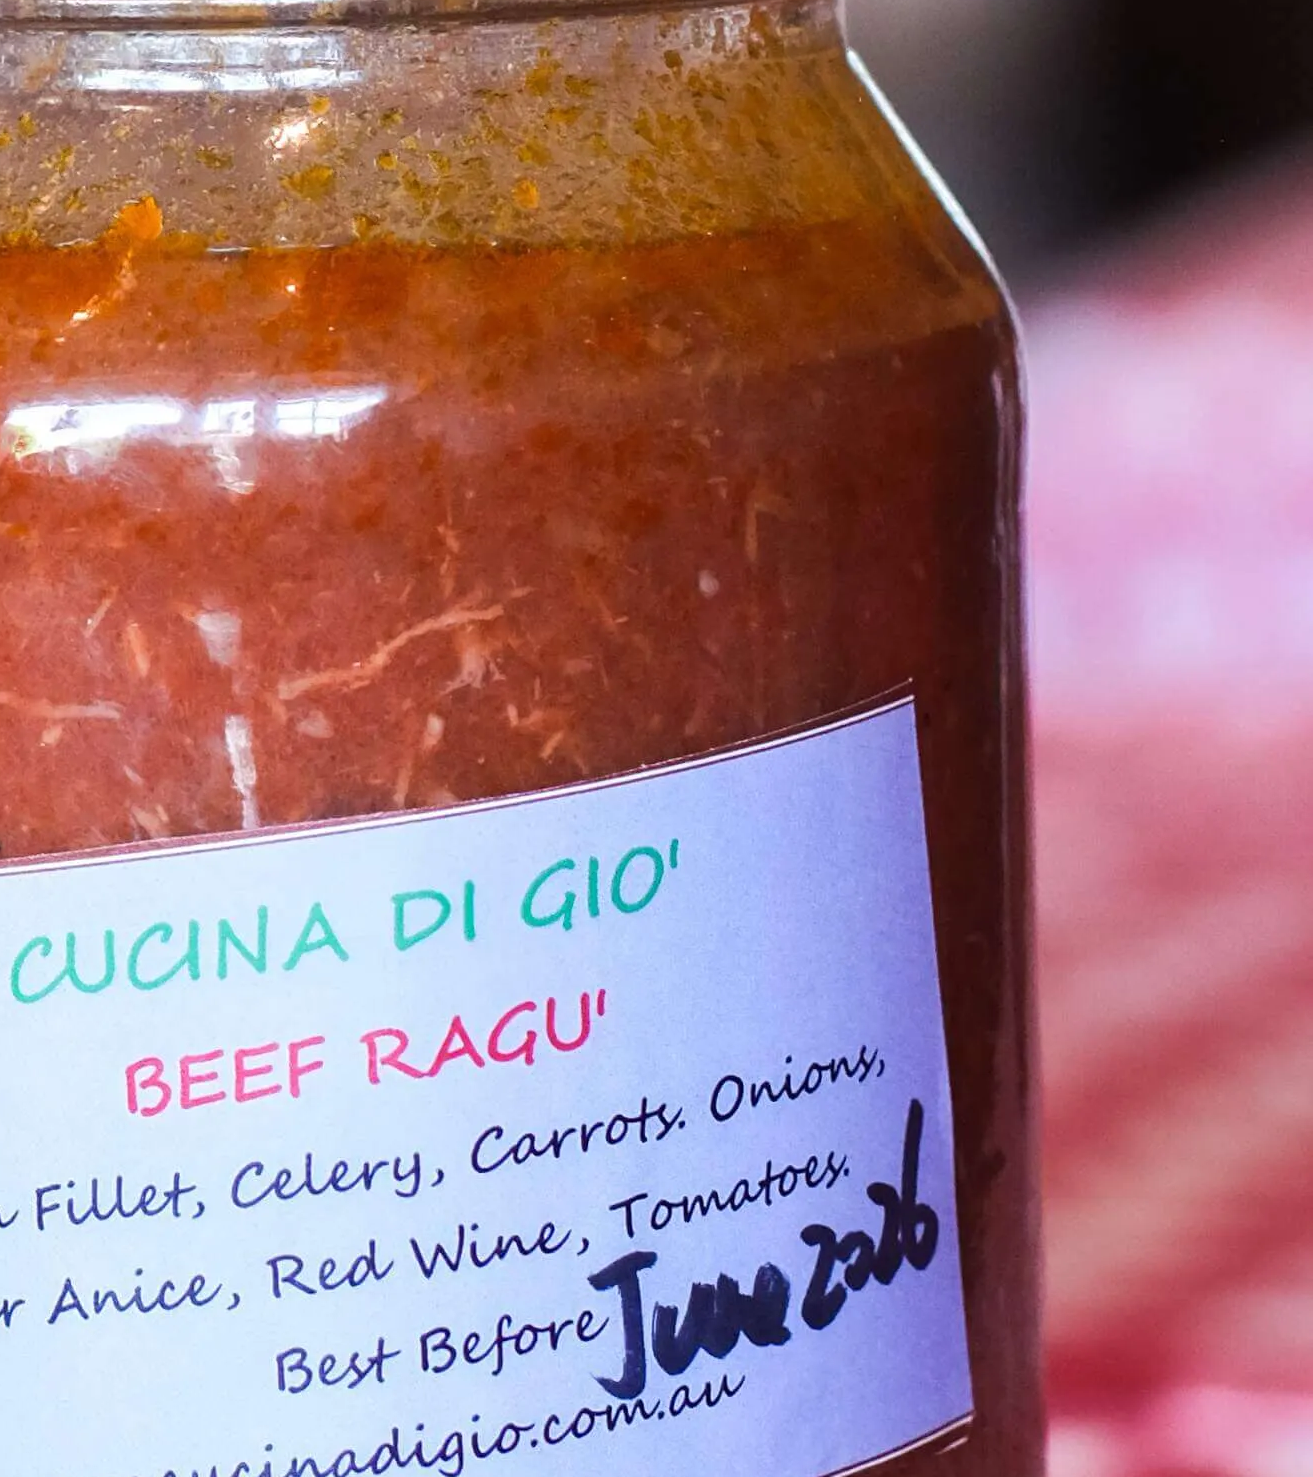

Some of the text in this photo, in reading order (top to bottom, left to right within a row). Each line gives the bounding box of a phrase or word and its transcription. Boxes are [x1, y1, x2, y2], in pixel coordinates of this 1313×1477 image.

[9, 837, 681, 1006] CUCINA DI GIO'
[123, 988, 609, 1119] BEEF RAGU'
[33, 1169, 207, 1233] Fillet,
[230, 1149, 446, 1213] Celery,
[469, 1097, 687, 1177] Carrots.
[709, 1044, 887, 1123] Onions,
[46, 1266, 242, 1326] Anice,
[264, 1239, 396, 1300] Red
[409, 1219, 591, 1281] Wine,
[608, 1150, 850, 1239] Tomatoes.
[273, 1309, 611, 1396] Best Before
[586, 1250, 792, 1401] June
